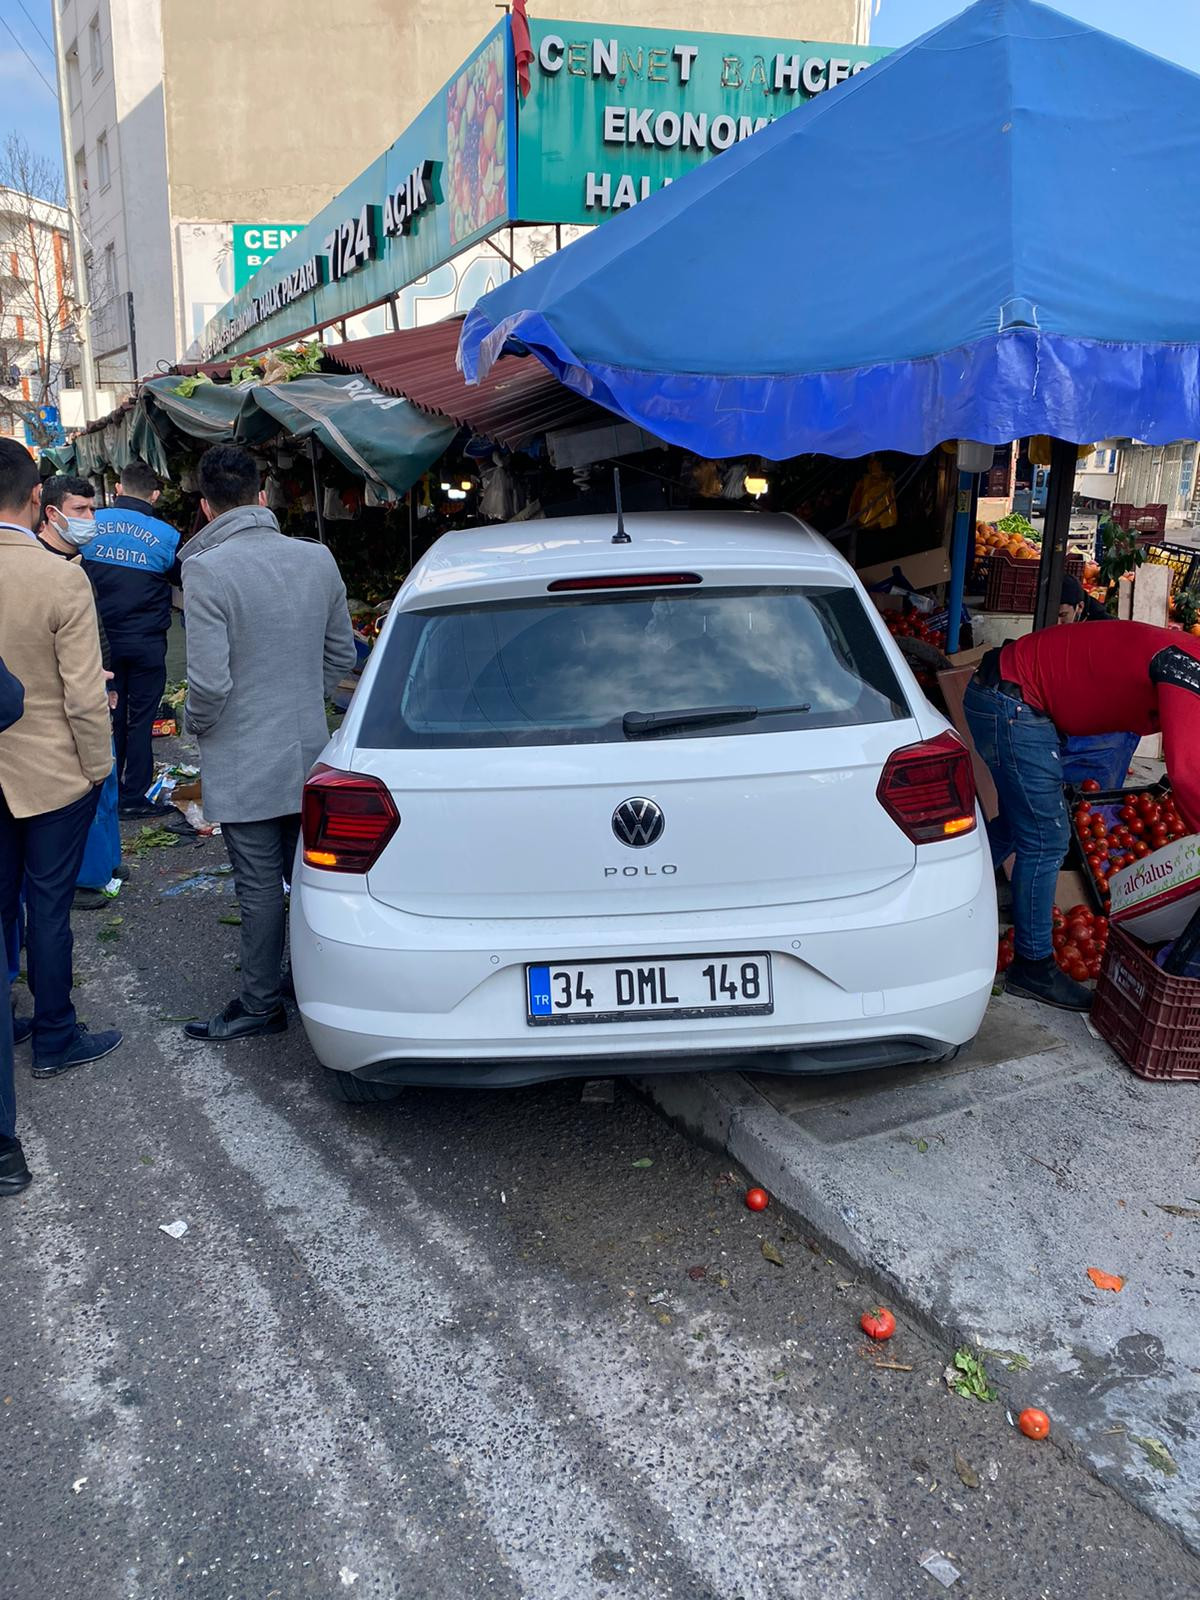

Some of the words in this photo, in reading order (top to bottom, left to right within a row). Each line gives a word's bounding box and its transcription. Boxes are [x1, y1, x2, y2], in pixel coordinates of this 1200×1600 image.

[540, 35, 698, 82] CENNET
[586, 172, 673, 208] HAL
[260, 283, 281, 321] HALK
[282, 255, 318, 305] PAZARI
[383, 160, 430, 236] AÇIK
[95, 521, 159, 547] SENYURT
[96, 544, 147, 565] ZABITA
[604, 864, 678, 877] POLO
[534, 994, 549, 1005] TR
[552, 971, 594, 1008] 34
[615, 967, 679, 1006] DML
[702, 963, 760, 1001] 148
